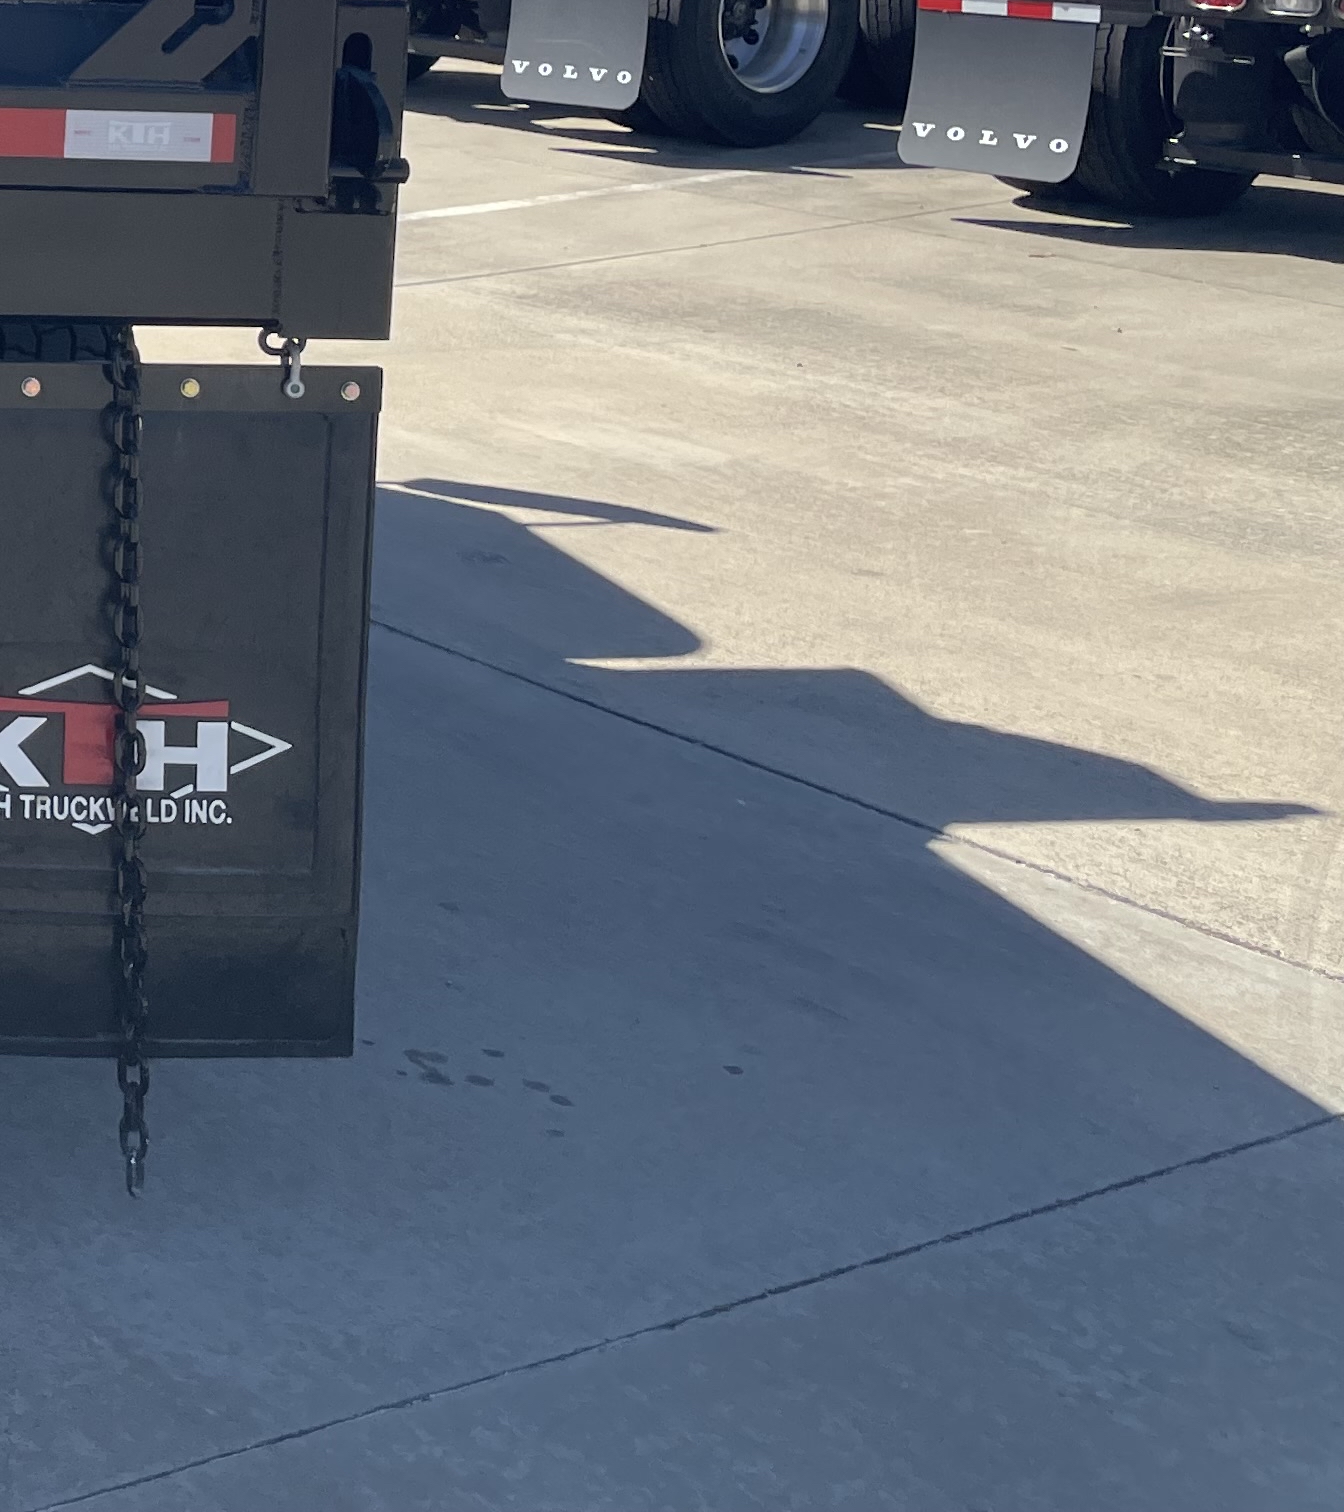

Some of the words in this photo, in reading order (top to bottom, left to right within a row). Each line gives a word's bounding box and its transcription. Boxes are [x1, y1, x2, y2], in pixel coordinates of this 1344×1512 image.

[511, 59, 633, 85] VOLVO
[912, 121, 1069, 154] VOLVO
[184, 798, 234, 825] INC.
